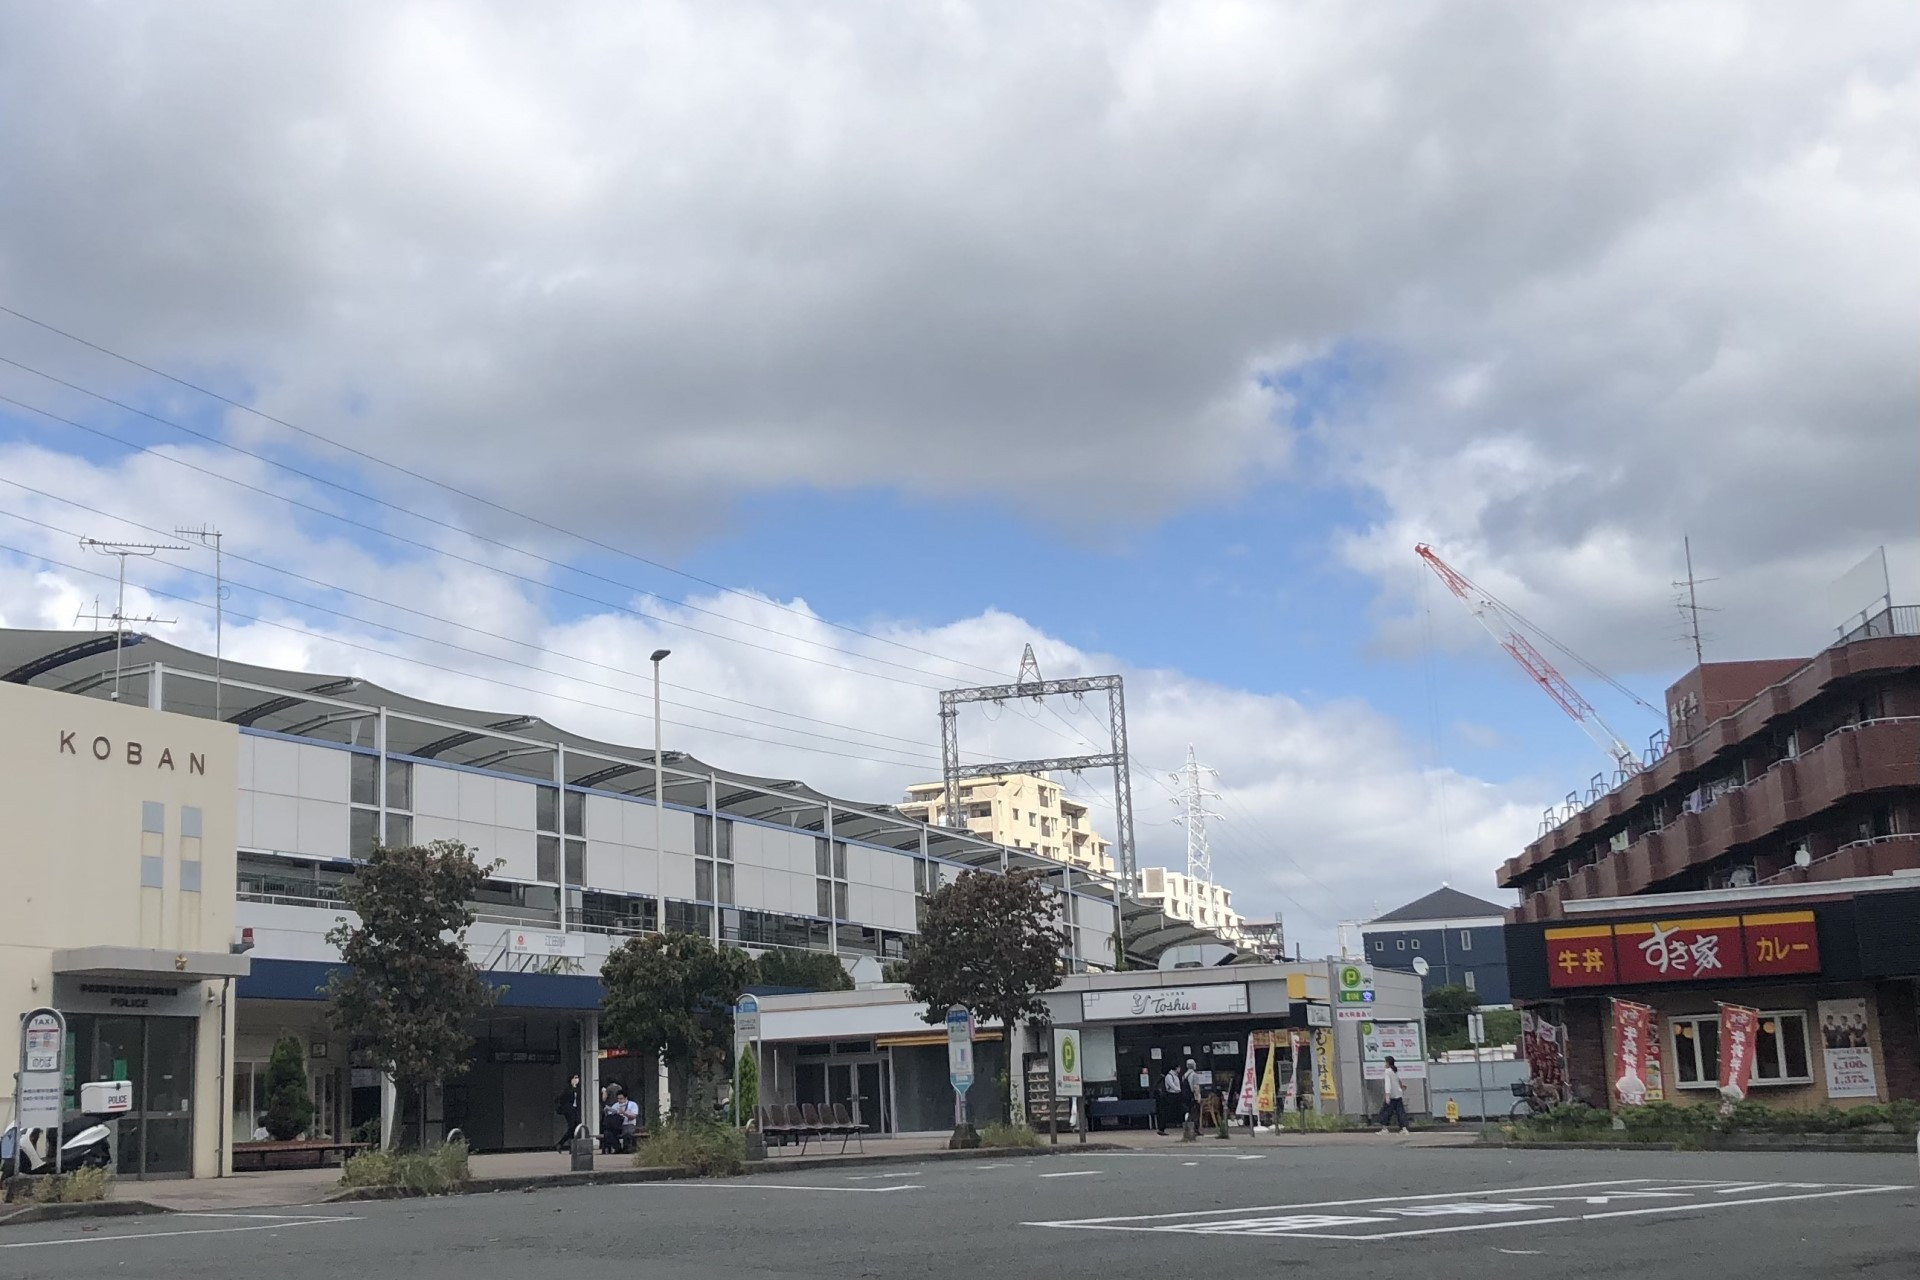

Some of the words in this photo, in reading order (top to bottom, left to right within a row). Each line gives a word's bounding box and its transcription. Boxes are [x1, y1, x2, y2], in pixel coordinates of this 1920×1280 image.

[60, 730, 205, 776] KOBAN
[1558, 947, 1605, 974] 牛丼
[1638, 921, 1722, 977] すき家
[1756, 936, 1809, 962] カレー
[111, 997, 149, 1008] POLICE
[1151, 998, 1190, 1013] Toshu
[108, 1094, 128, 1105] POLICE
